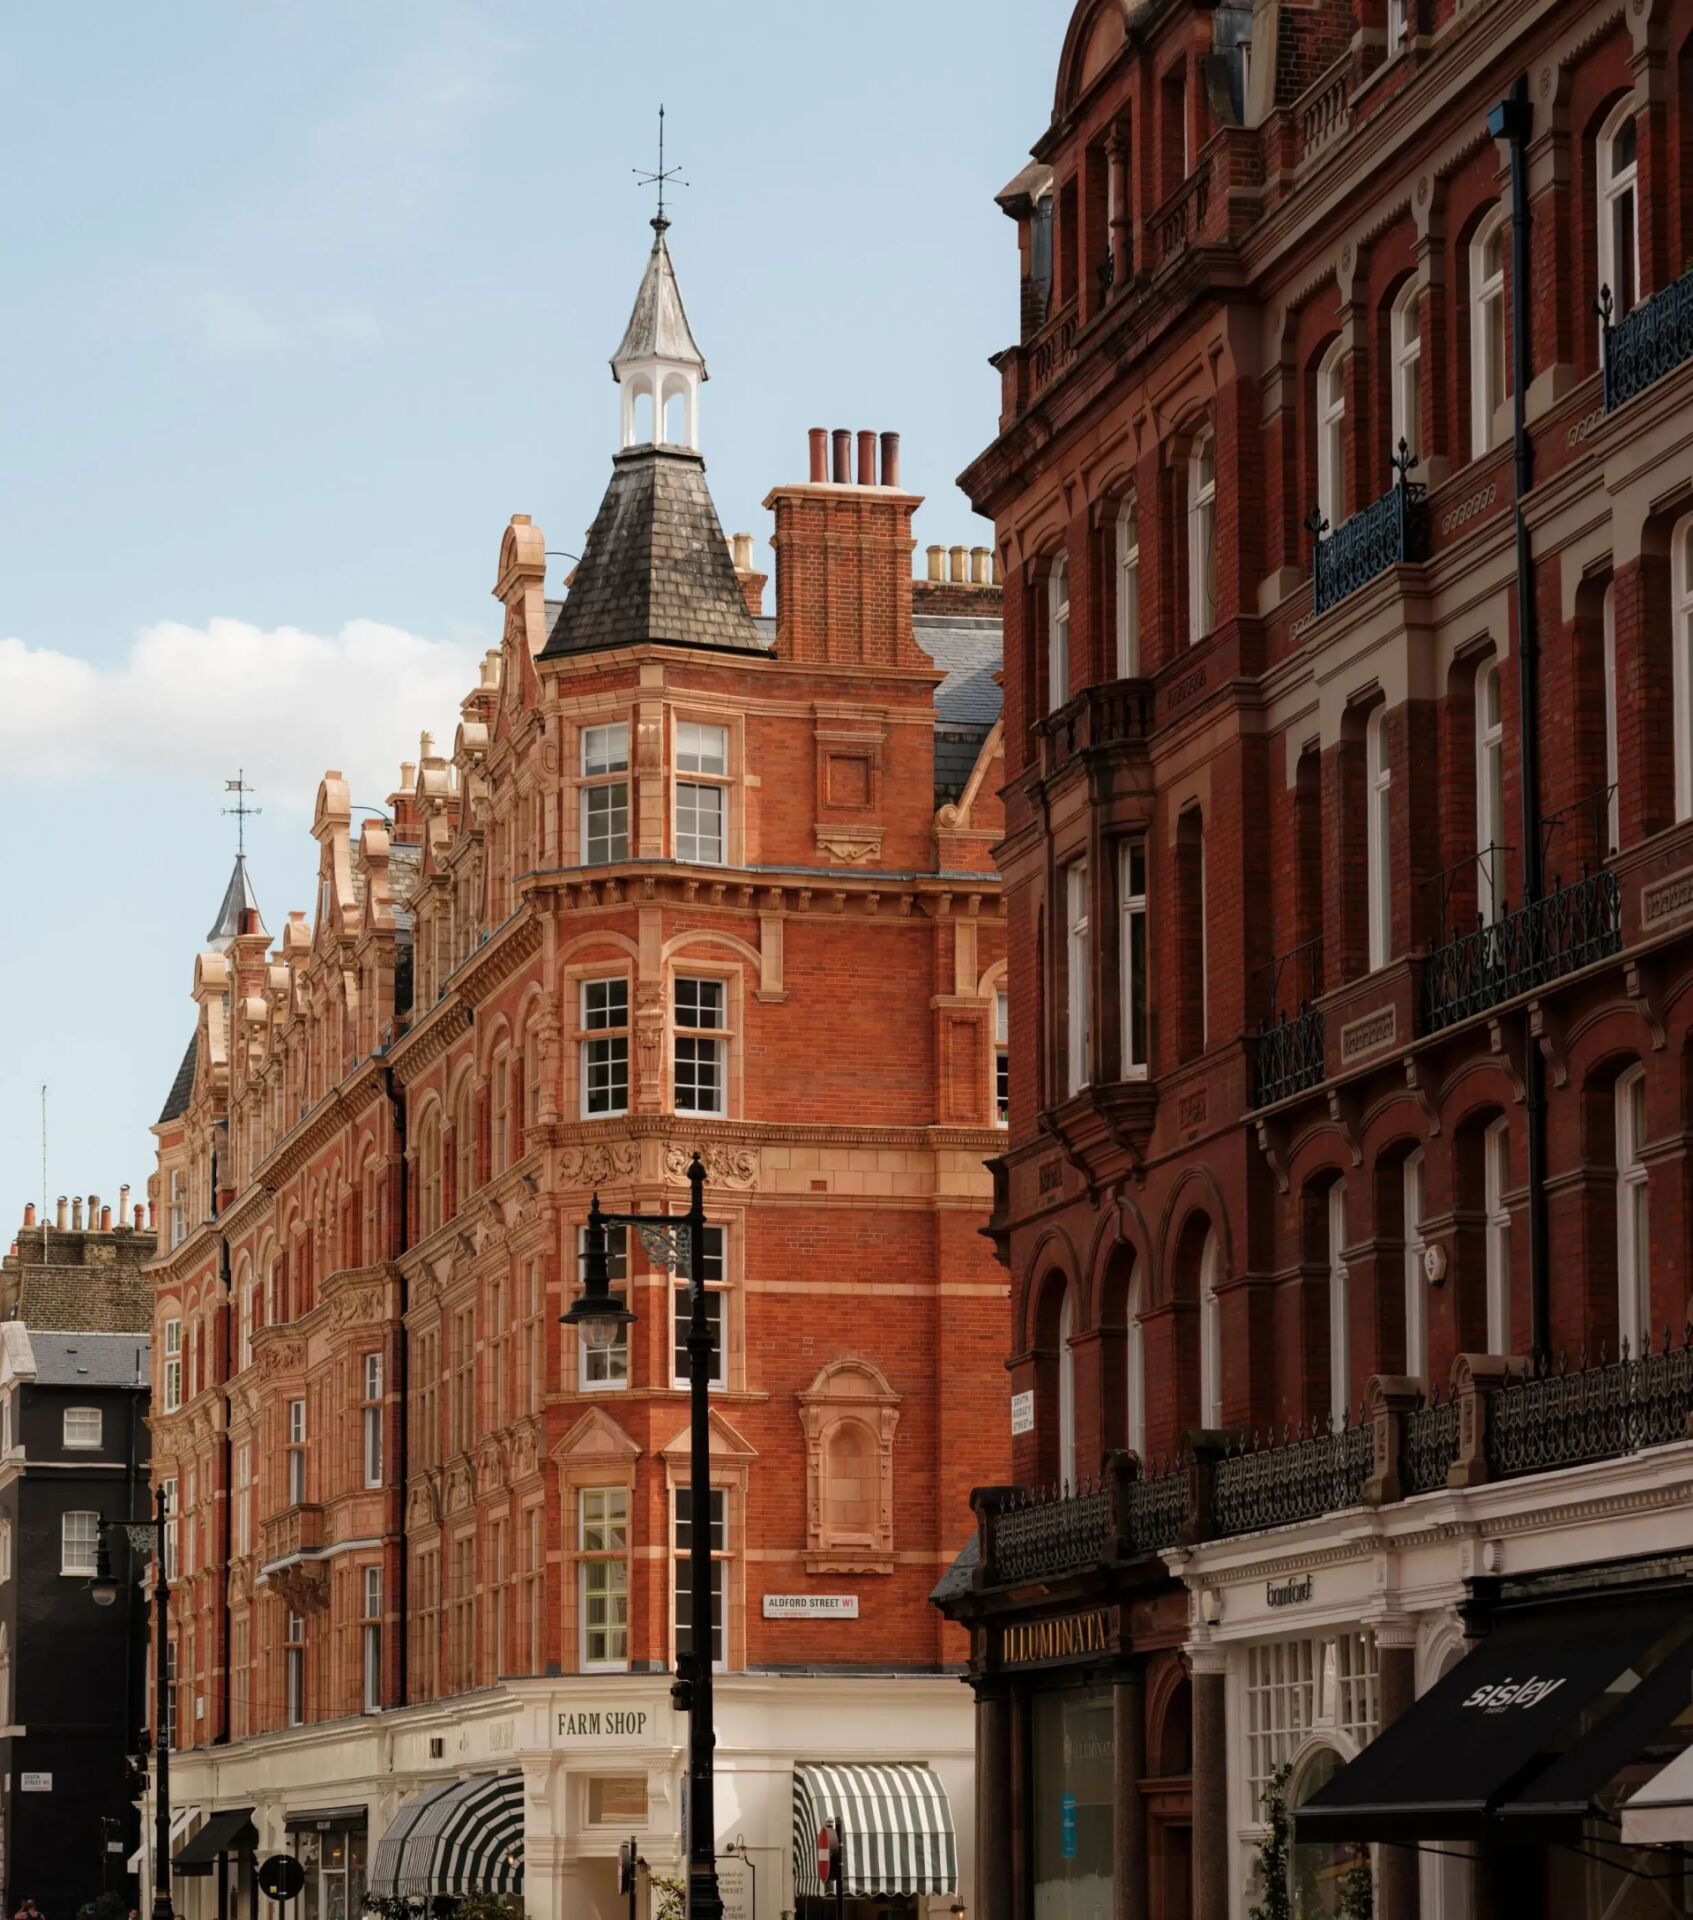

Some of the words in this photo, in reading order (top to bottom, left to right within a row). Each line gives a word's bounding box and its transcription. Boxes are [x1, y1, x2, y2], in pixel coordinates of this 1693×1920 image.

[1013, 1395, 1029, 1406] SOUTH
[1013, 1405, 1031, 1418] AUDLEY
[1013, 1418, 1029, 1431] STREET
[768, 1598, 807, 1608] ALDFORD
[809, 1598, 840, 1608] STREET
[842, 1598, 854, 1608] W1
[1003, 1611, 1106, 1664] ILLUMINATA
[1462, 1675, 1567, 1709] sisley
[558, 1713, 601, 1736] FARM
[605, 1712, 647, 1735] SHOP
